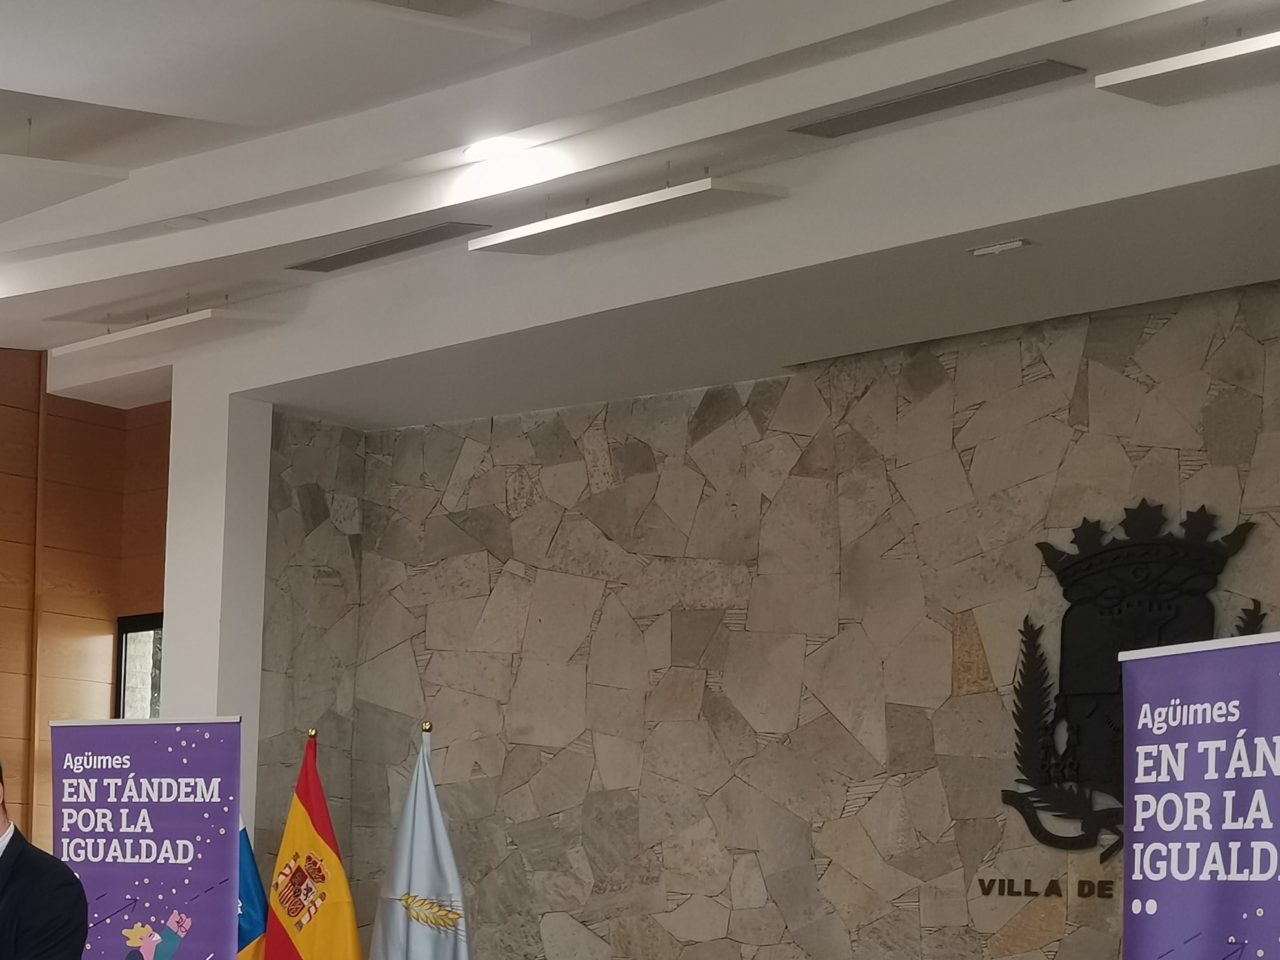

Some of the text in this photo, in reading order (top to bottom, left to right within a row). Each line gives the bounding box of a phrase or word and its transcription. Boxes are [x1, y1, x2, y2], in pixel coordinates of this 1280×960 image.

[1137, 699, 1240, 735] Agüimes
[63, 752, 131, 773] Agüimes
[1134, 728, 1280, 784] EN TÁN
[62, 772, 222, 803] EN TÁNDEM
[61, 808, 154, 833] POR LA
[1133, 789, 1273, 832] POR LA
[60, 838, 195, 864] IGUALDAD
[1131, 841, 1280, 881] IGUALD
[978, 878, 1114, 899] VILLA DE
